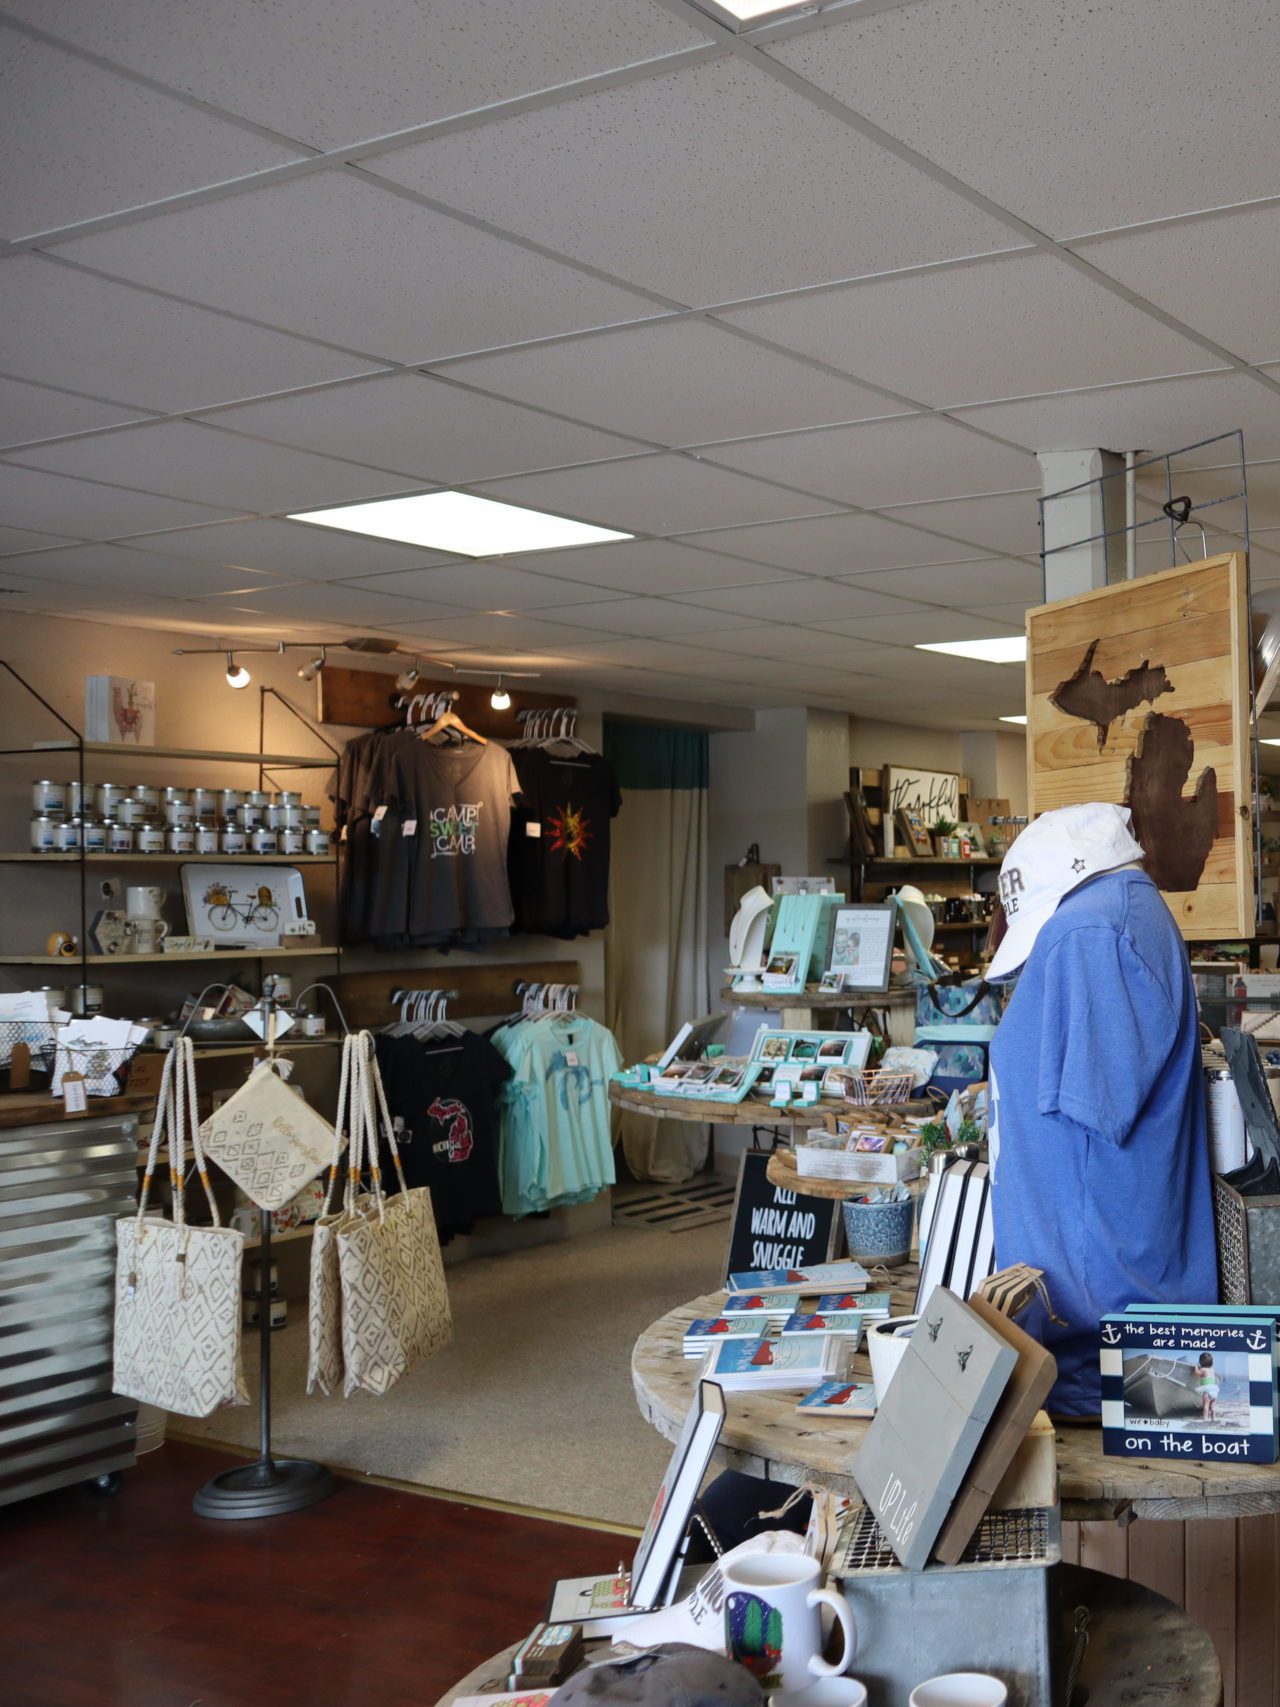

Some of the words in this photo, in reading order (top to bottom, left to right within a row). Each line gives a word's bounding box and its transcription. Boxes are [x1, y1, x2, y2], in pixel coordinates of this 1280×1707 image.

[430, 821, 479, 838] SWEET
[751, 1207, 788, 1239] WARM
[787, 1210, 816, 1240] AND
[750, 1240, 805, 1271] SNUGGLE
[1124, 1324, 1145, 1335] the
[1149, 1323, 1176, 1336] best
[1181, 1326, 1244, 1338] memories
[1152, 1338, 1176, 1348] are
[1180, 1337, 1216, 1349] made
[1149, 1418, 1170, 1428] baby
[1125, 1437, 1151, 1450] on
[1159, 1434, 1193, 1453] the
[1201, 1435, 1251, 1456] boat
[880, 1472, 902, 1517] UP
[889, 1489, 918, 1545] Life
